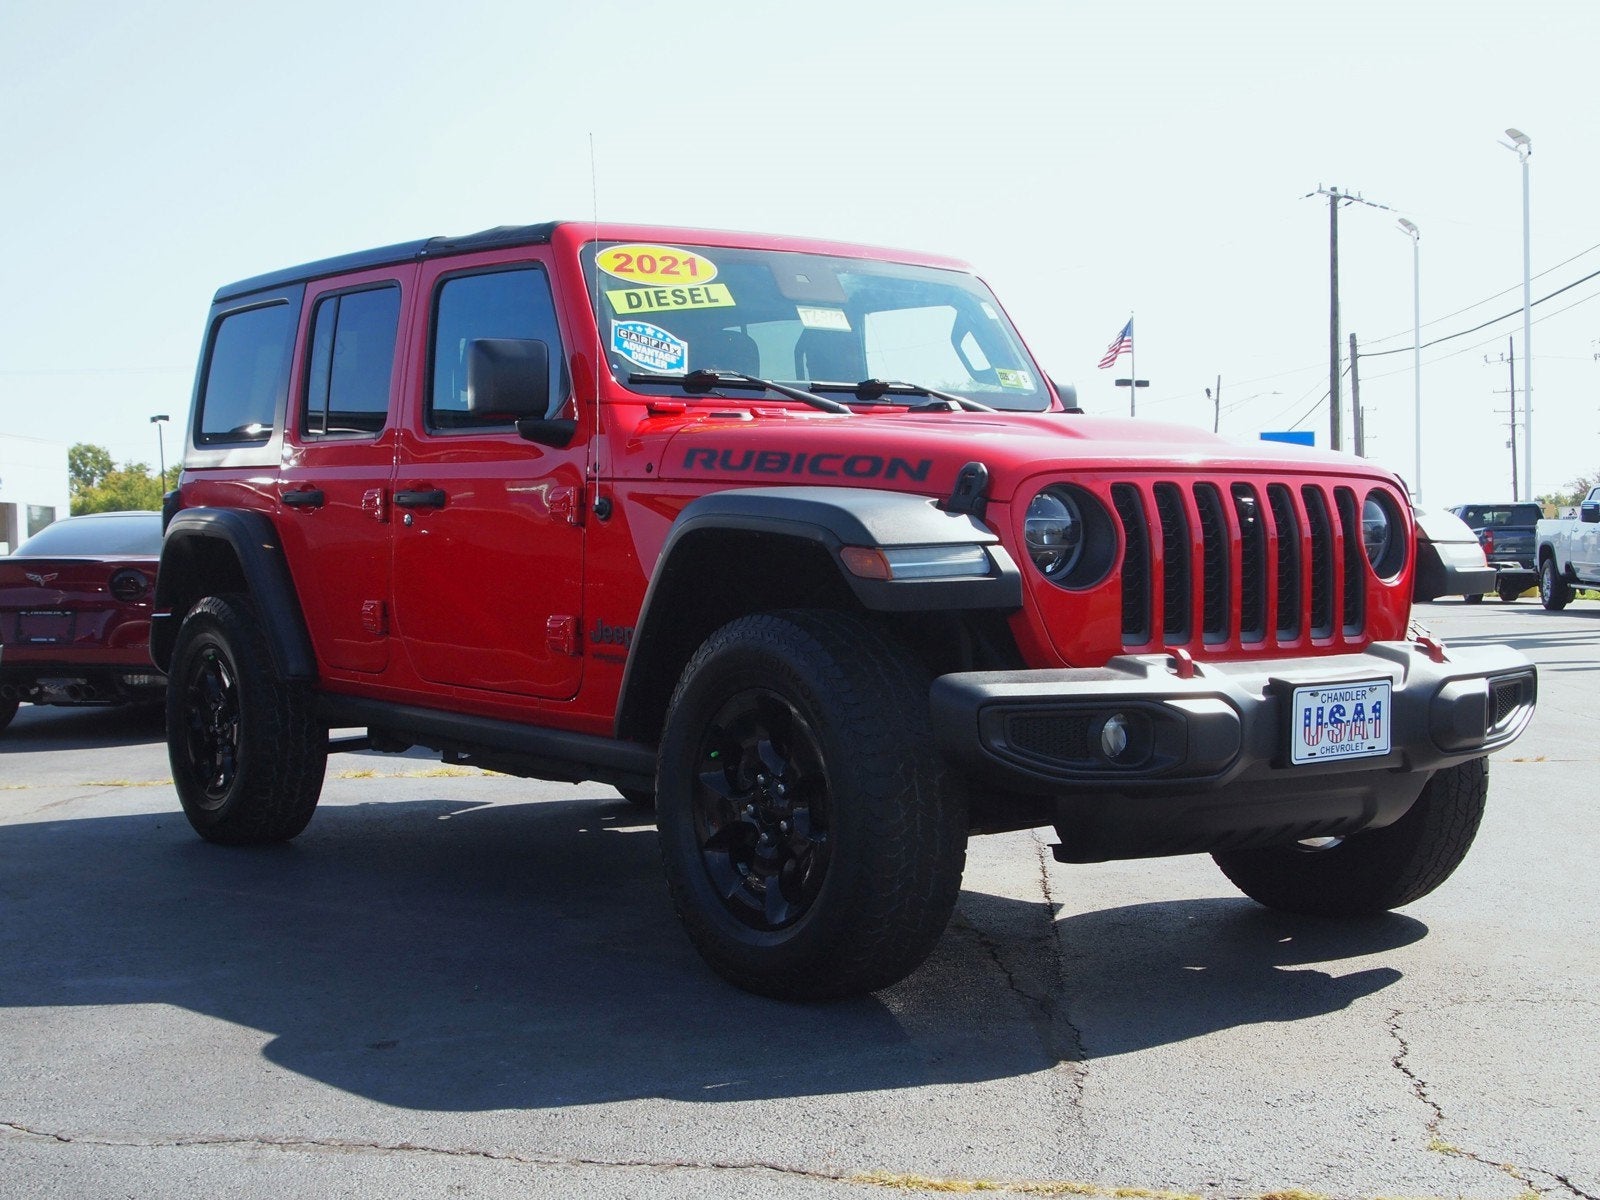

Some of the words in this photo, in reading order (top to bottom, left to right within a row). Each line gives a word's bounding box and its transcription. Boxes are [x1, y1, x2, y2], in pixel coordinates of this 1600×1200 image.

[613, 253, 699, 276] 2021
[625, 286, 719, 309] DIESEL
[618, 328, 681, 354] CARFAX
[622, 340, 677, 364] ADVANTAGE
[632, 351, 668, 369] DEALER
[682, 447, 933, 482] RUBICON
[590, 617, 635, 649] Jeep
[1320, 689, 1367, 704] CHANDLER
[1320, 742, 1364, 755] CHEVROLET
